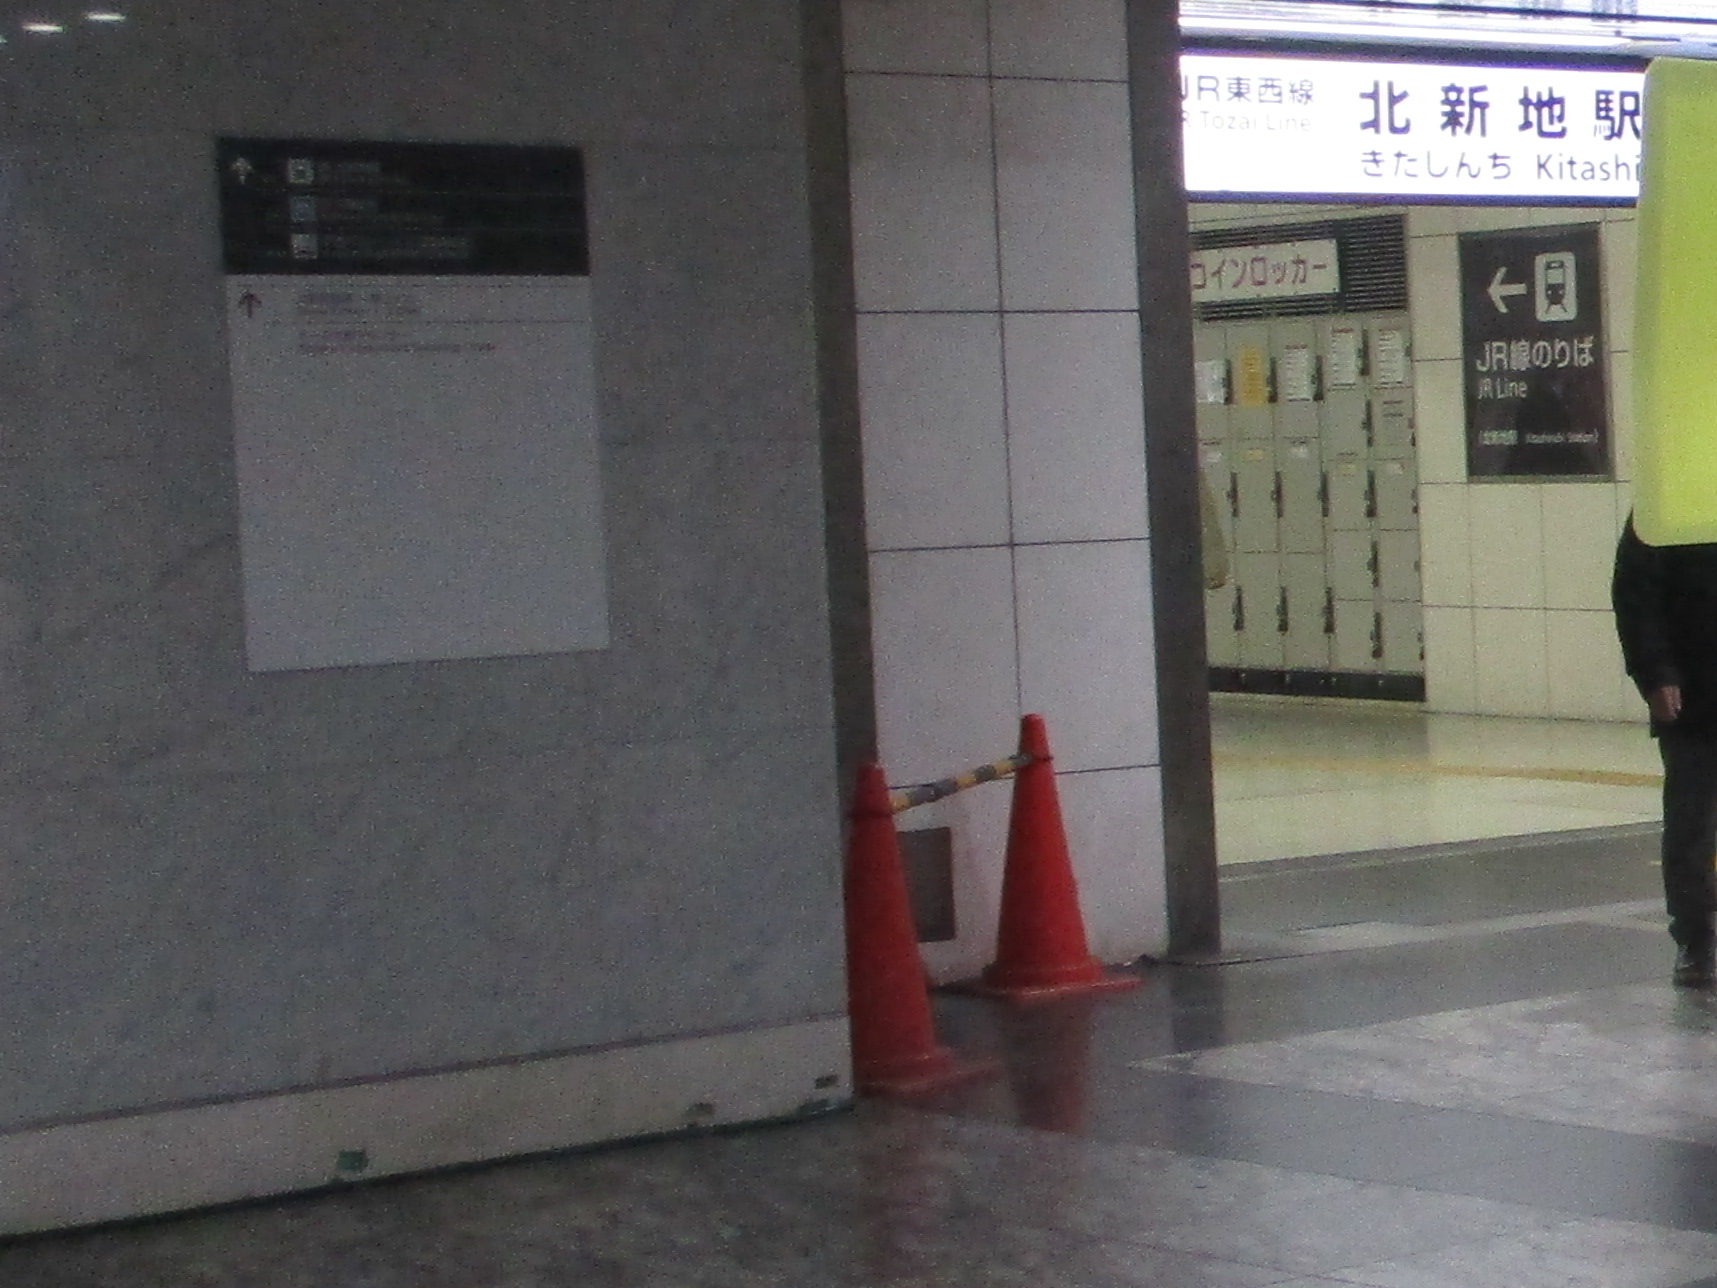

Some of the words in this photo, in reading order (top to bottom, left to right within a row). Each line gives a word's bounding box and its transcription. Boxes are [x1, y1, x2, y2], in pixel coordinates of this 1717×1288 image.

[1180, 73, 1315, 108] JR東西線
[1202, 110, 1258, 132] Tozai
[1264, 112, 1312, 133] Line
[1359, 79, 1643, 142] 北新地駅
[1360, 148, 1513, 181] きたしんち
[1190, 252, 1328, 291] コインロッカー
[1475, 334, 1596, 373] JR線のりば
[1478, 377, 1494, 400] JR
[1495, 376, 1529, 400] Line
